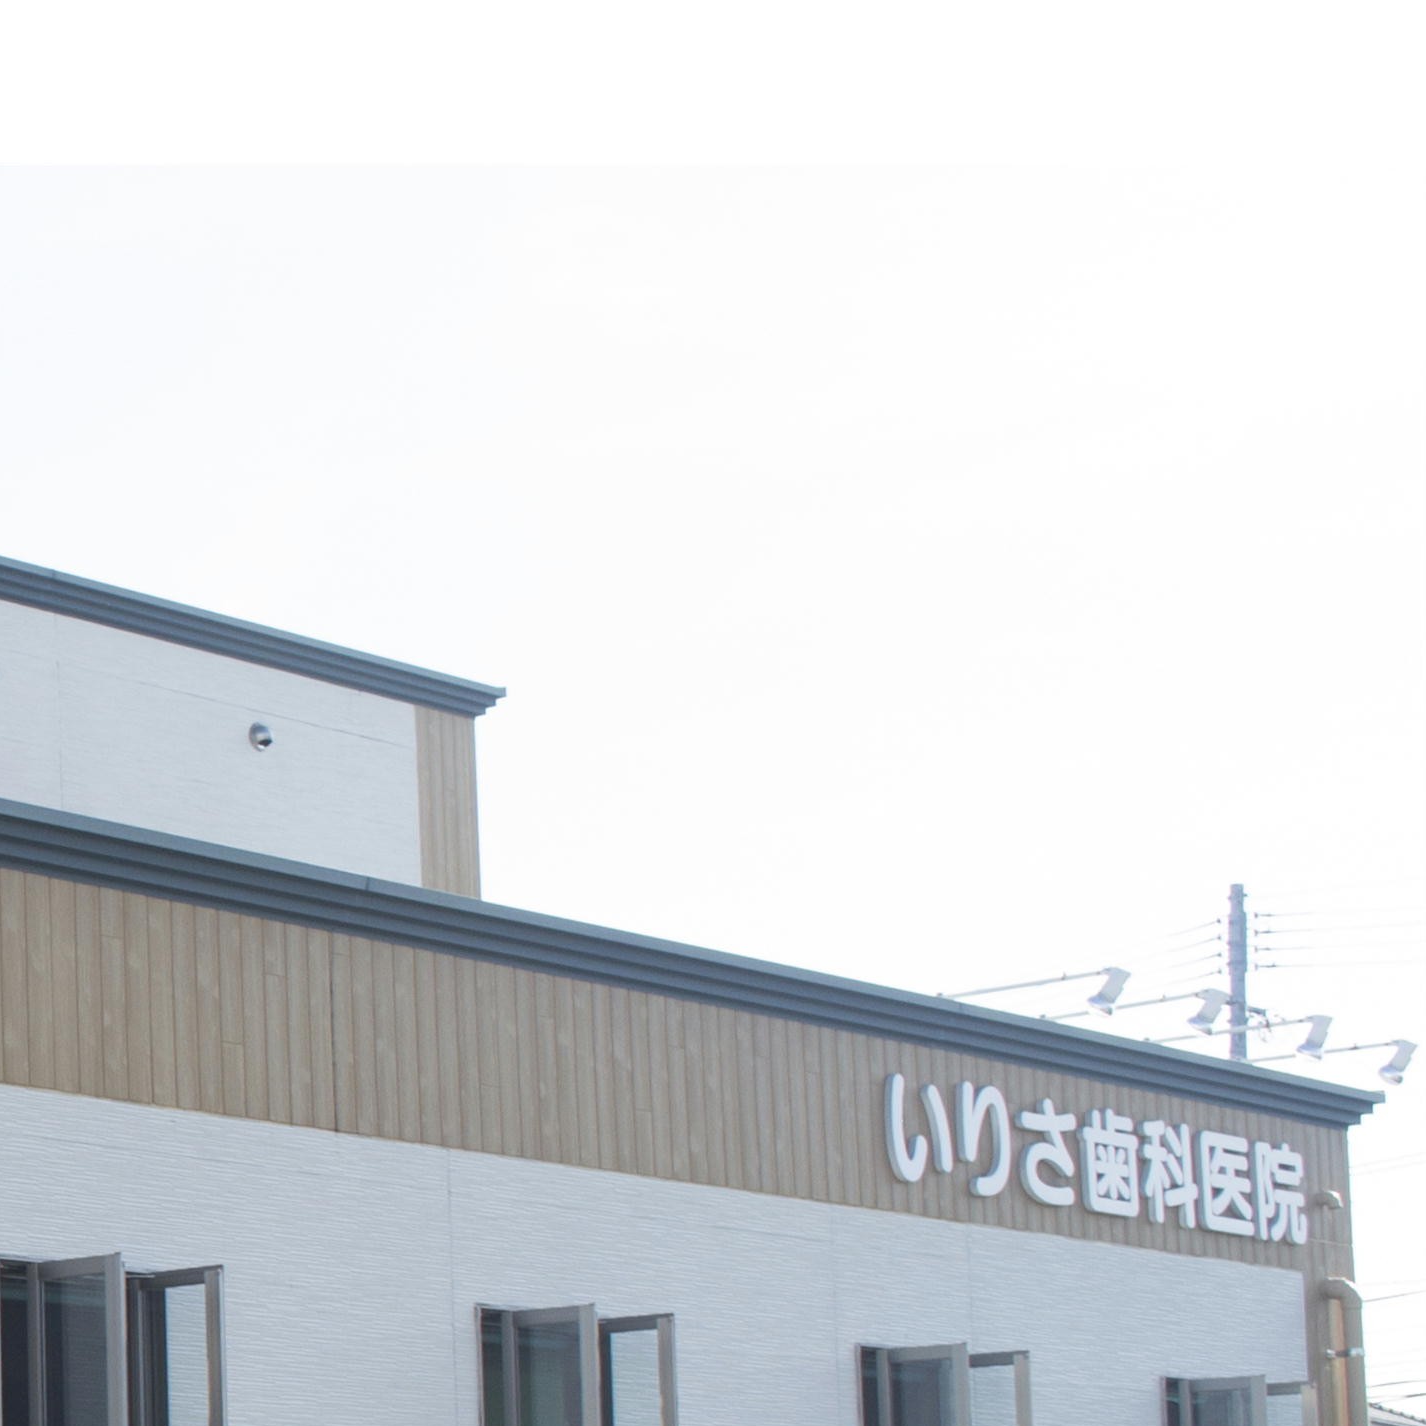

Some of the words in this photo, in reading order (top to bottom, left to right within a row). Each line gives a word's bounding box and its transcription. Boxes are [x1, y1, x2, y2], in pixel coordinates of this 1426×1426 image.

[884, 1073, 1308, 1245] いりさ歯科医院
